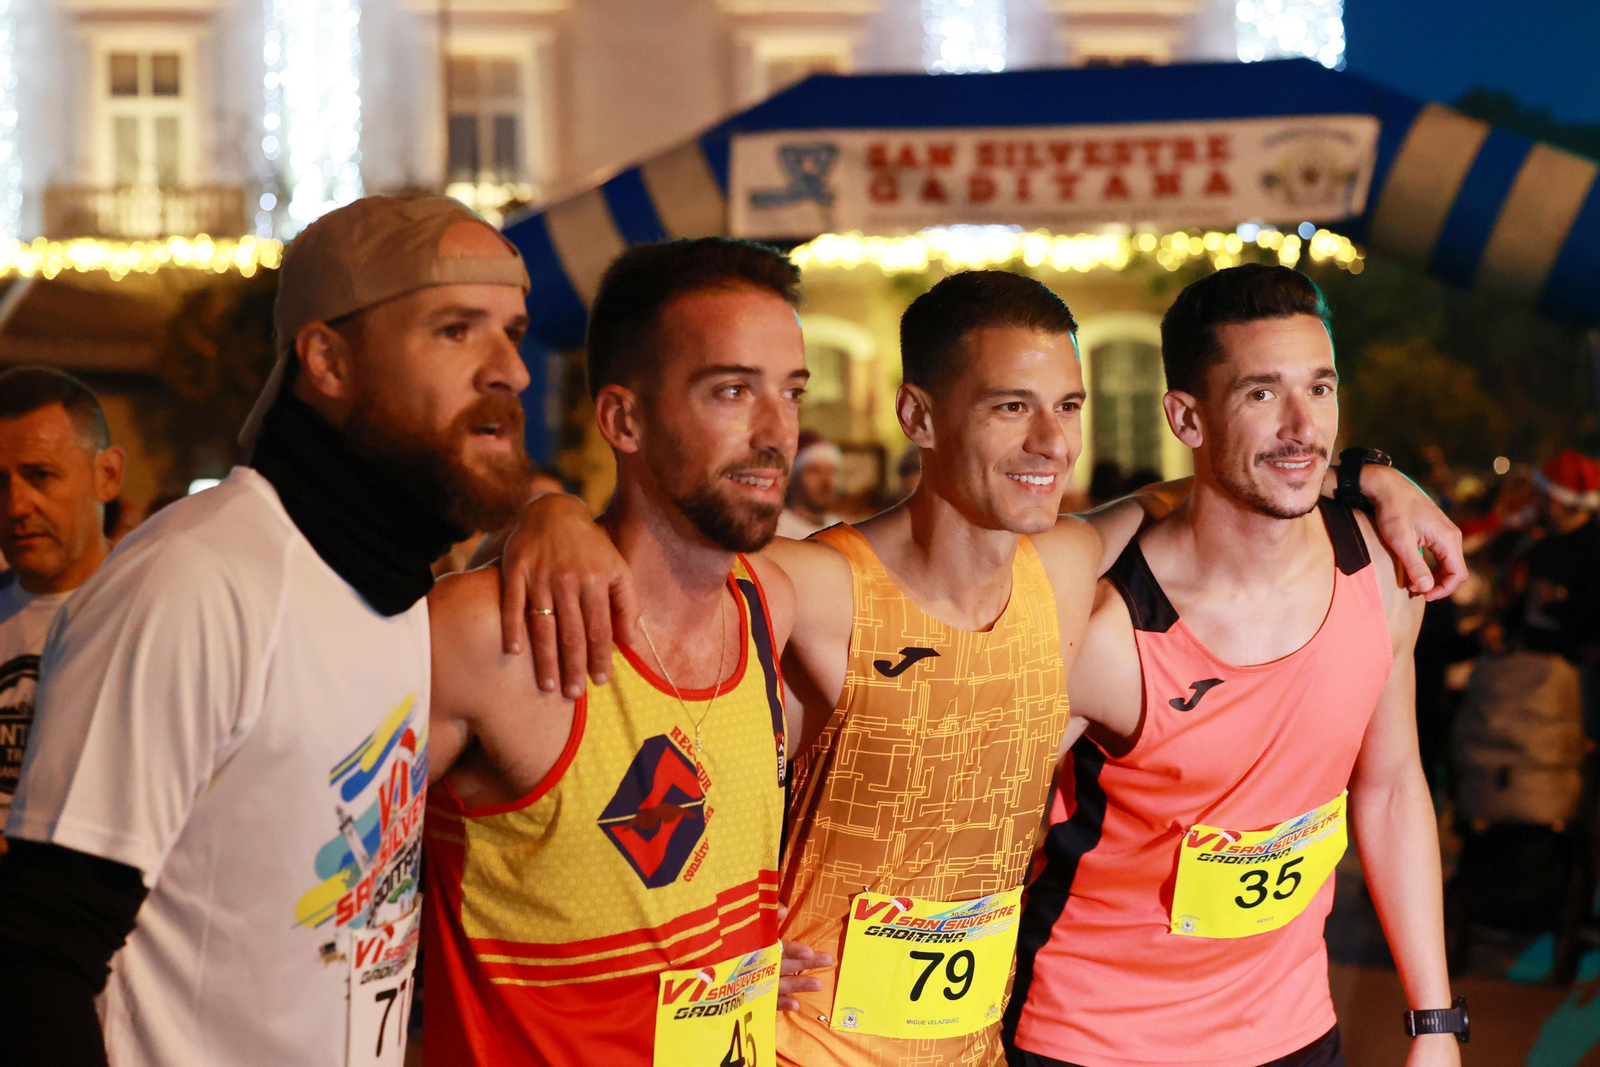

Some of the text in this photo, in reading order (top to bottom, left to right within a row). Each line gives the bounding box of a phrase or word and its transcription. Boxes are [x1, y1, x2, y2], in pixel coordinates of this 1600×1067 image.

[867, 141, 955, 169] SAN
[976, 134, 1231, 169] SILVESTRE
[867, 170, 1232, 205] GADITANA
[1226, 845, 1269, 855] SAN
[1270, 806, 1342, 851] SILVESTRE
[1197, 847, 1292, 865] GADITANA
[1234, 856, 1304, 909] 35
[854, 899, 902, 924] VI
[895, 916, 943, 931] SAN
[942, 904, 1017, 931] SILVESTRE
[864, 925, 967, 943] GADITANA
[705, 982, 736, 1001] SAN
[734, 963, 778, 994] SILVESTRE
[909, 949, 975, 1002] 79
[719, 1011, 757, 1067] 45
